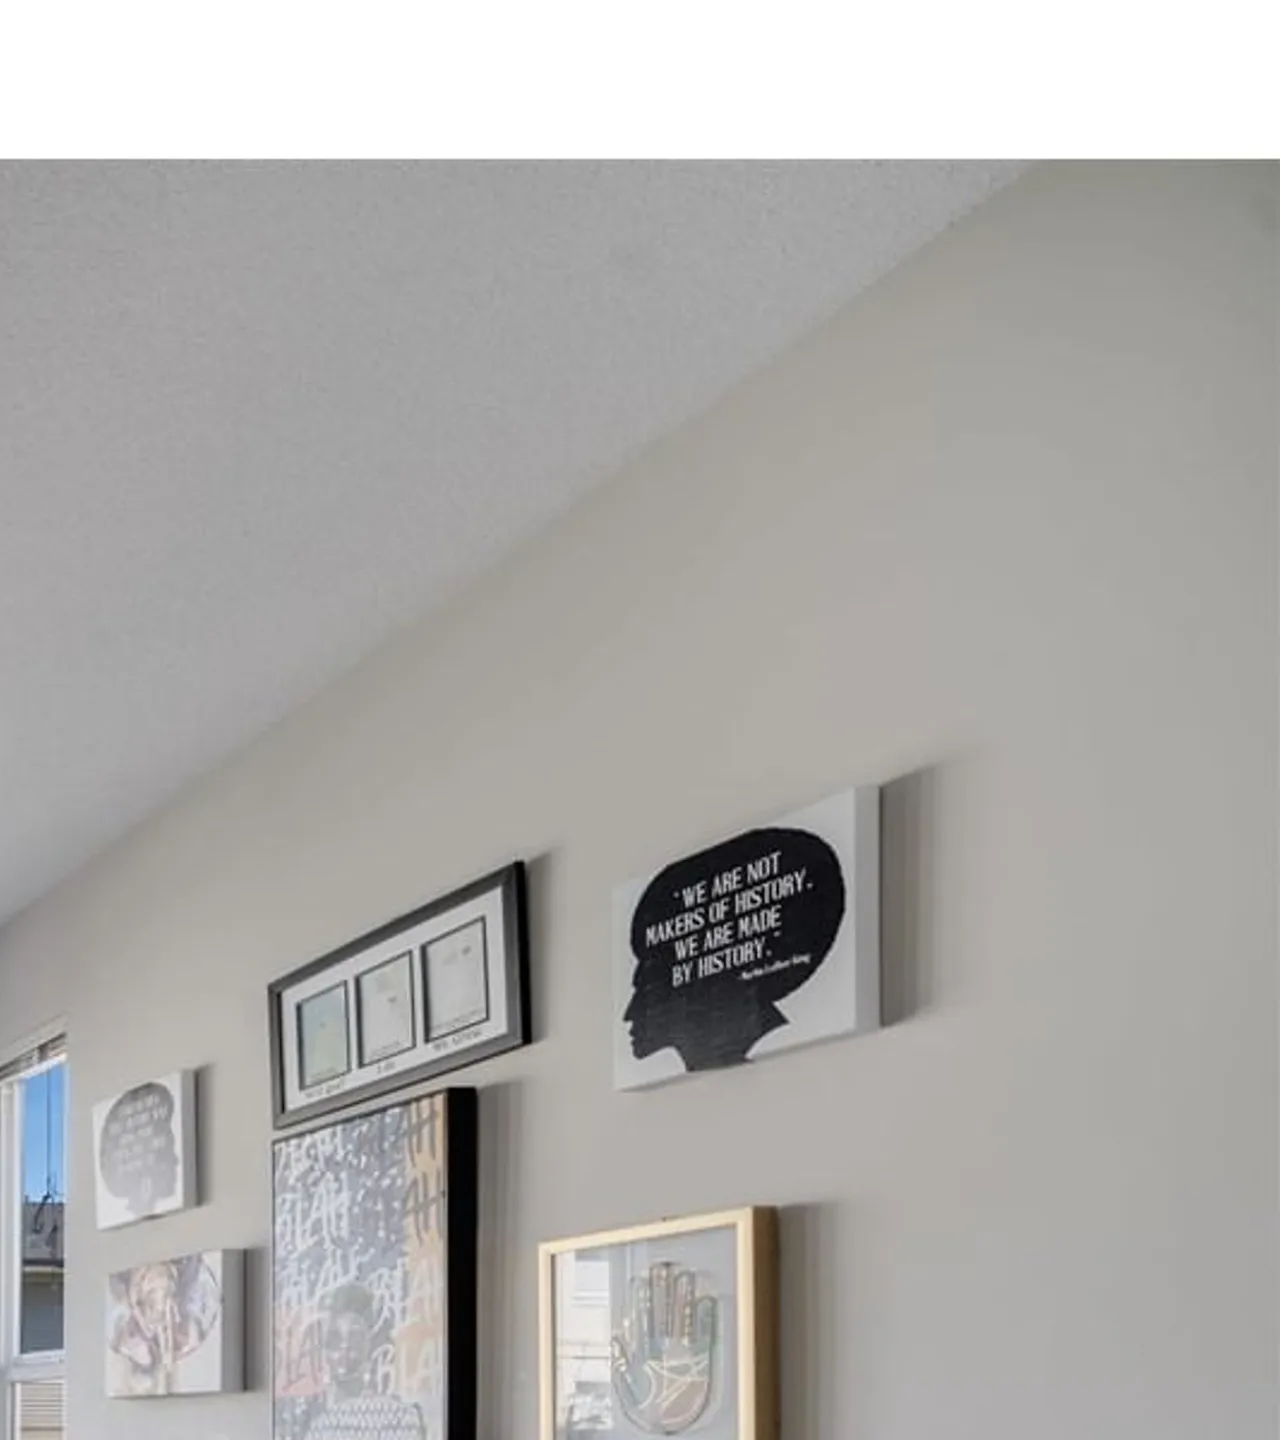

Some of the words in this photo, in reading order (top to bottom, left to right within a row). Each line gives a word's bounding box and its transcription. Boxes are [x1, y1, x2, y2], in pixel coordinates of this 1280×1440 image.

[682, 880, 706, 908] WE
[711, 867, 741, 895] ARE
[747, 851, 781, 884] NOT
[646, 908, 705, 947] MAKERS
[708, 897, 730, 924] OF
[674, 934, 698, 960] WE
[704, 921, 732, 951] ARE
[738, 905, 781, 939] MADE
[672, 964, 693, 988] BY
